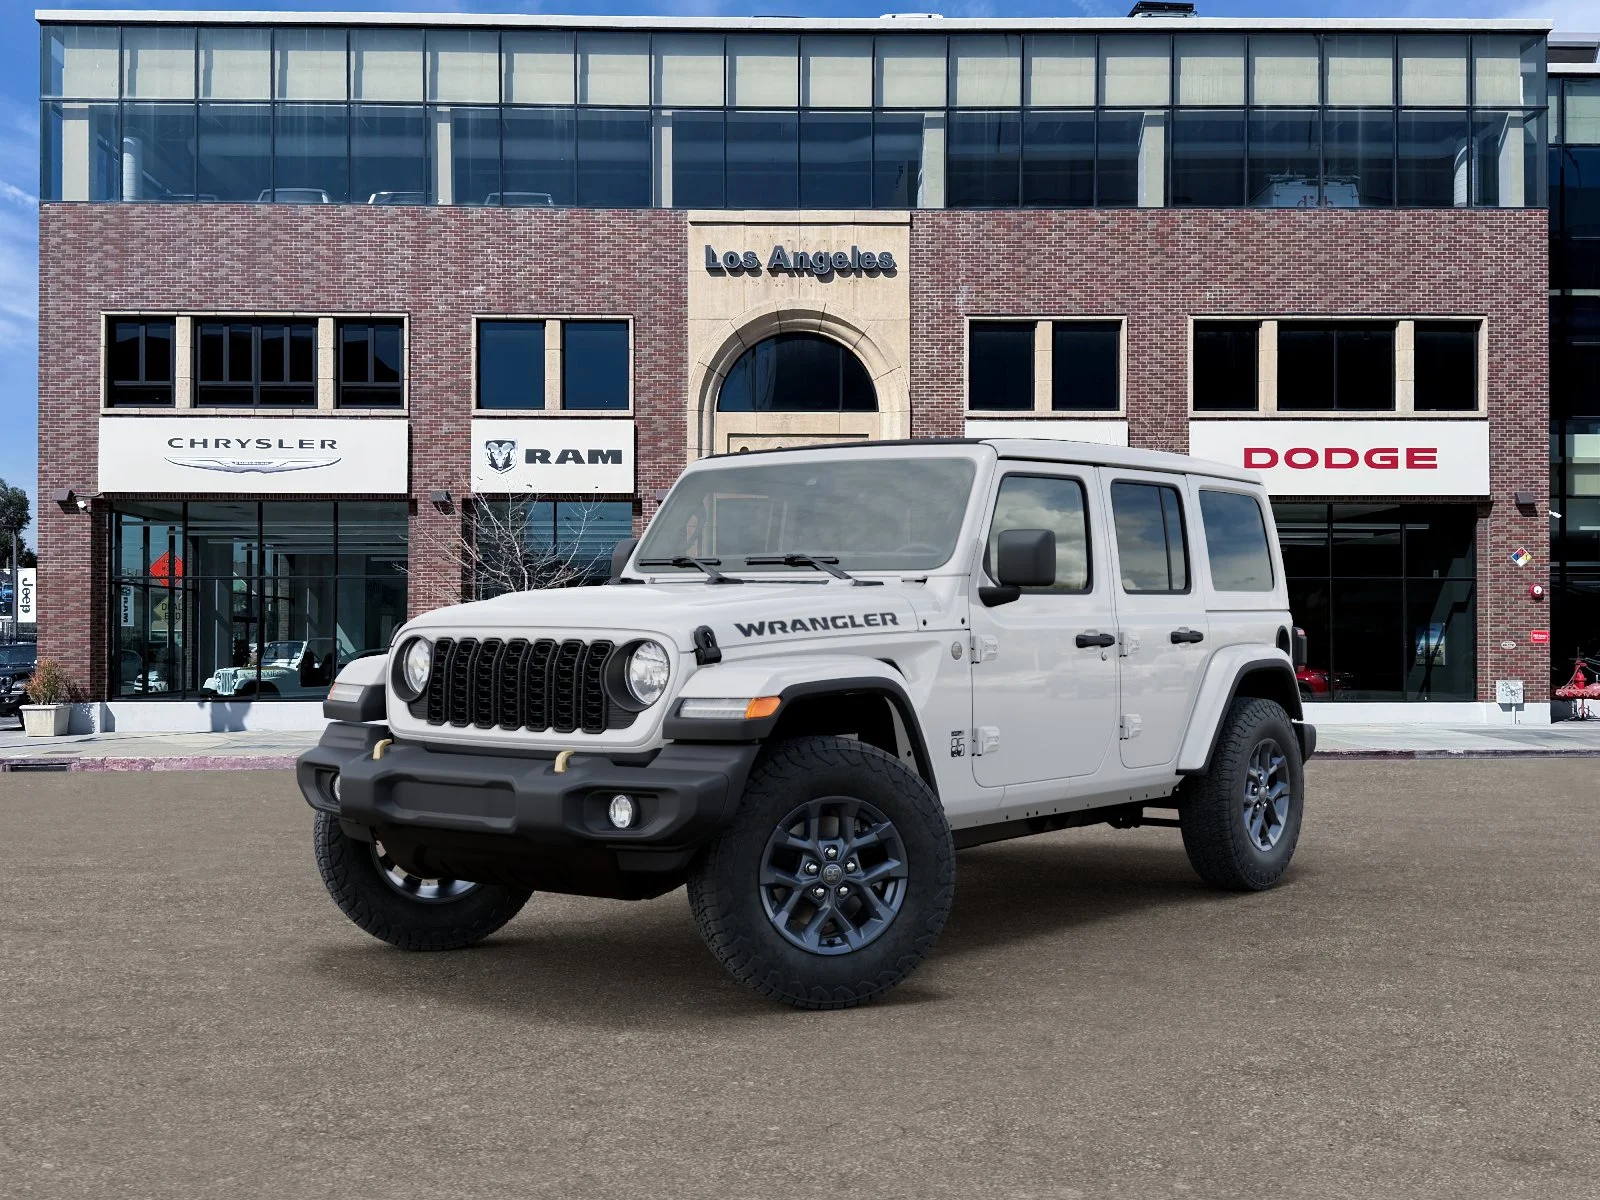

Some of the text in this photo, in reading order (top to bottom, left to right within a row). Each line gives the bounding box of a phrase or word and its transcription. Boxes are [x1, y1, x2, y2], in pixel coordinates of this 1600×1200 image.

[704, 244, 894, 275] Los Angeles
[167, 437, 338, 449] CHRYSLER
[524, 448, 623, 465] RAM
[1243, 447, 1438, 469] DODGE
[20, 577, 34, 614] Jeep
[165, 612, 181, 620] ED
[734, 612, 899, 637] WRANGLER
